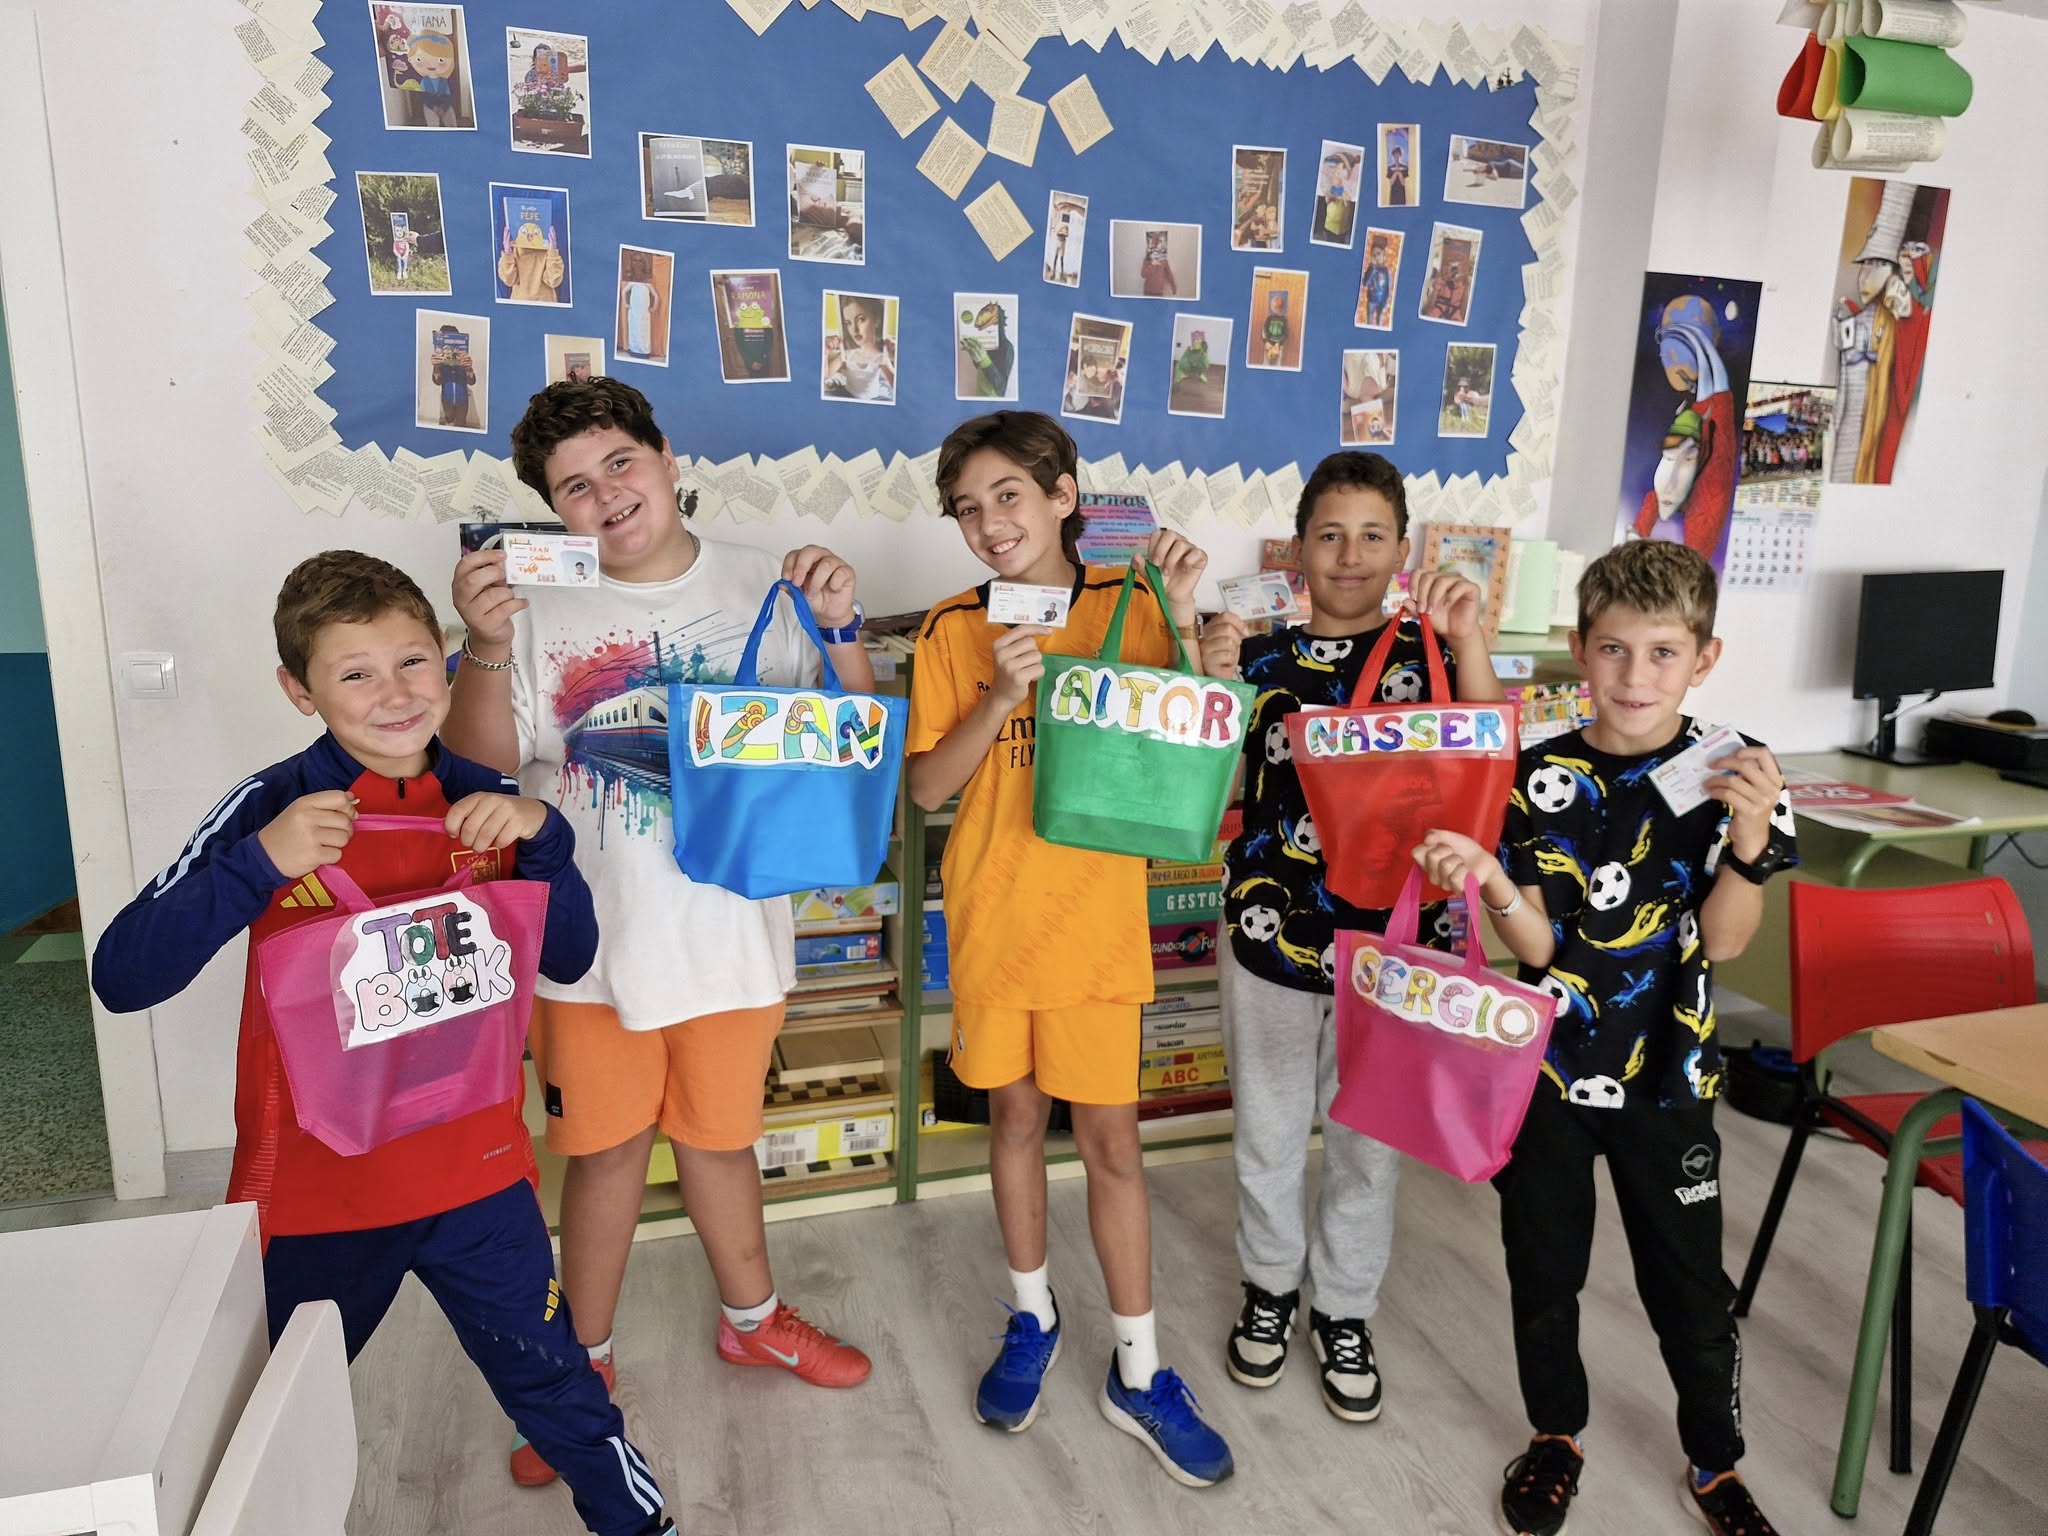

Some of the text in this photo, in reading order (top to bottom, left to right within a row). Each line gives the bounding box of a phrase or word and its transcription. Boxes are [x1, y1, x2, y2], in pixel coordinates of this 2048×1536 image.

[695, 695, 884, 764] IZAN
[1056, 669, 1233, 741] AITOR
[1310, 711, 1502, 754] NASSER
[1166, 890, 1226, 911] GESTOS
[362, 901, 479, 973] TOTE
[355, 944, 513, 1032] BOOK
[1355, 951, 1536, 1045] SERGIO
[1161, 1066, 1200, 1086] ABC
